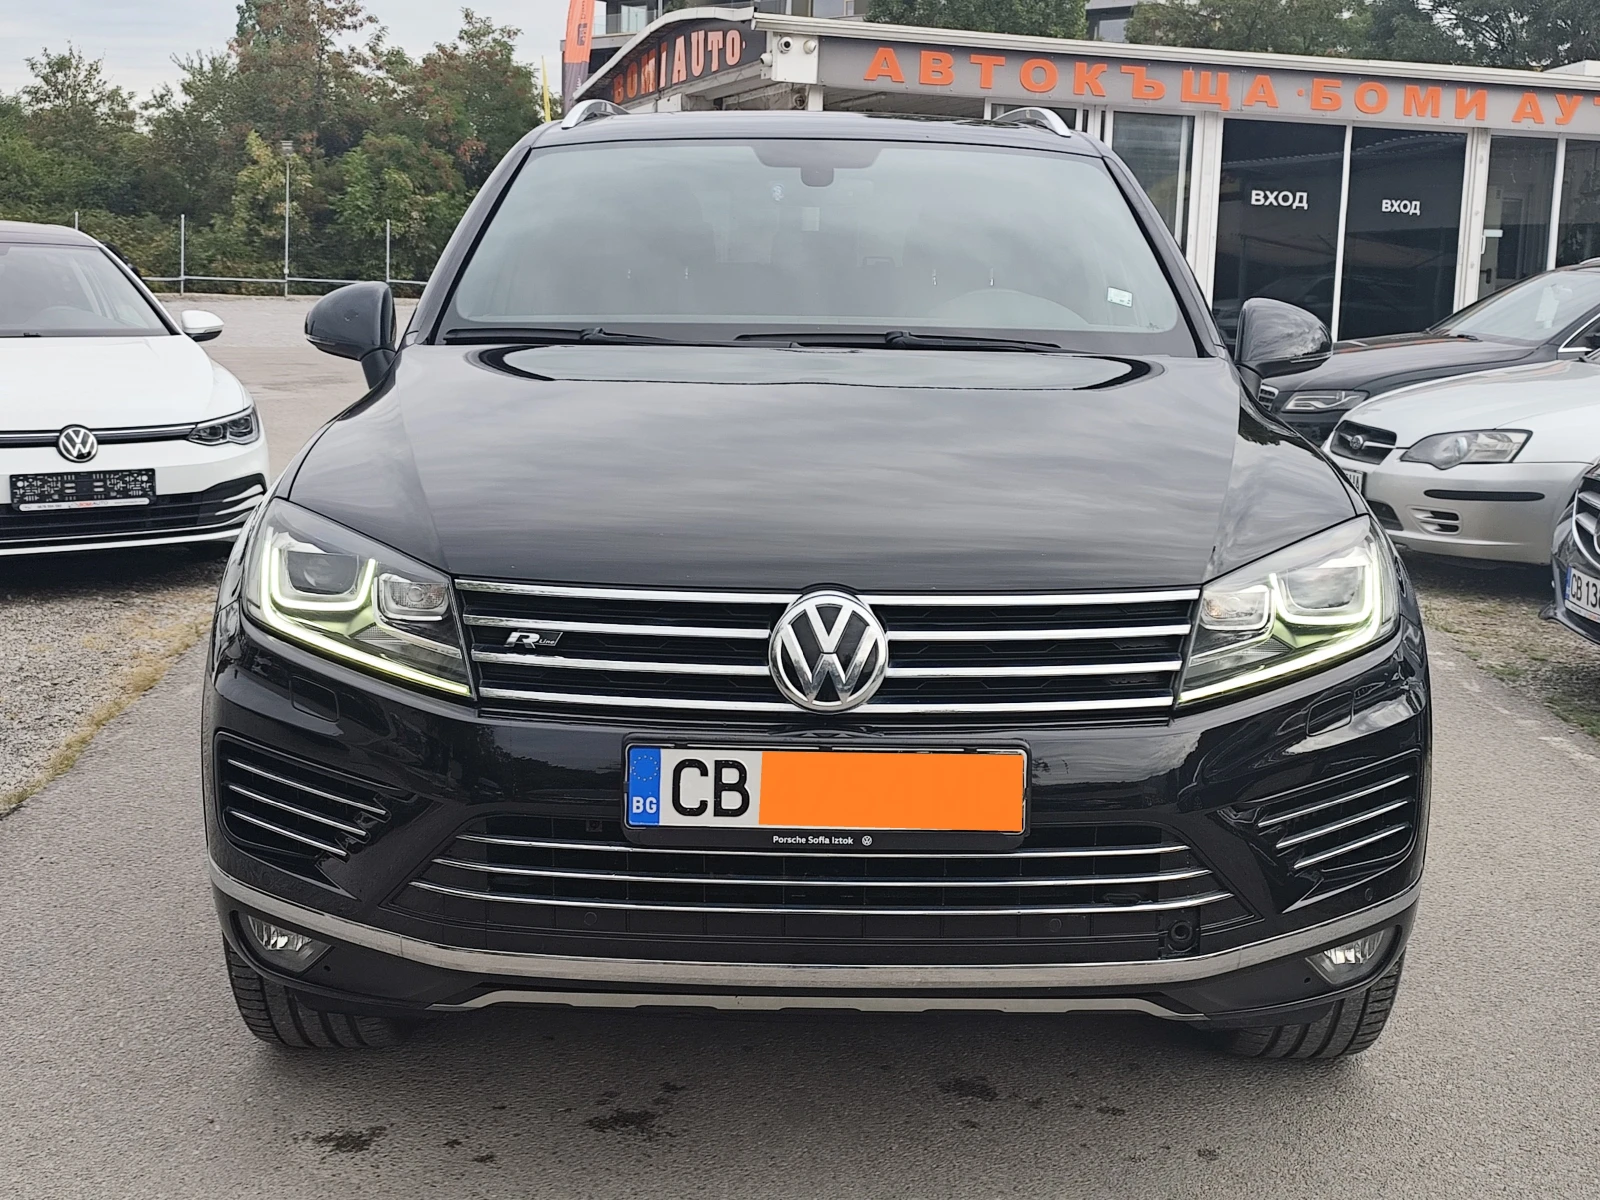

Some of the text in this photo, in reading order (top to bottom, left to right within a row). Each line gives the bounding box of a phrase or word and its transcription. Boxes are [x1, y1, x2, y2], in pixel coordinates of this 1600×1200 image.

[863, 46, 1279, 112] АВТОКЪЩА
[1310, 78, 1488, 121] БОМИ
[1250, 189, 1309, 211] ВХОД
[1381, 199, 1421, 216] ВХОД
[1586, 580, 1600, 609] 13
[503, 631, 541, 649] R
[671, 758, 750, 818] CB
[632, 796, 658, 815] BG
[772, 835, 806, 844] Porsche
[808, 835, 830, 844] Sofia
[832, 836, 854, 845] Iztok
